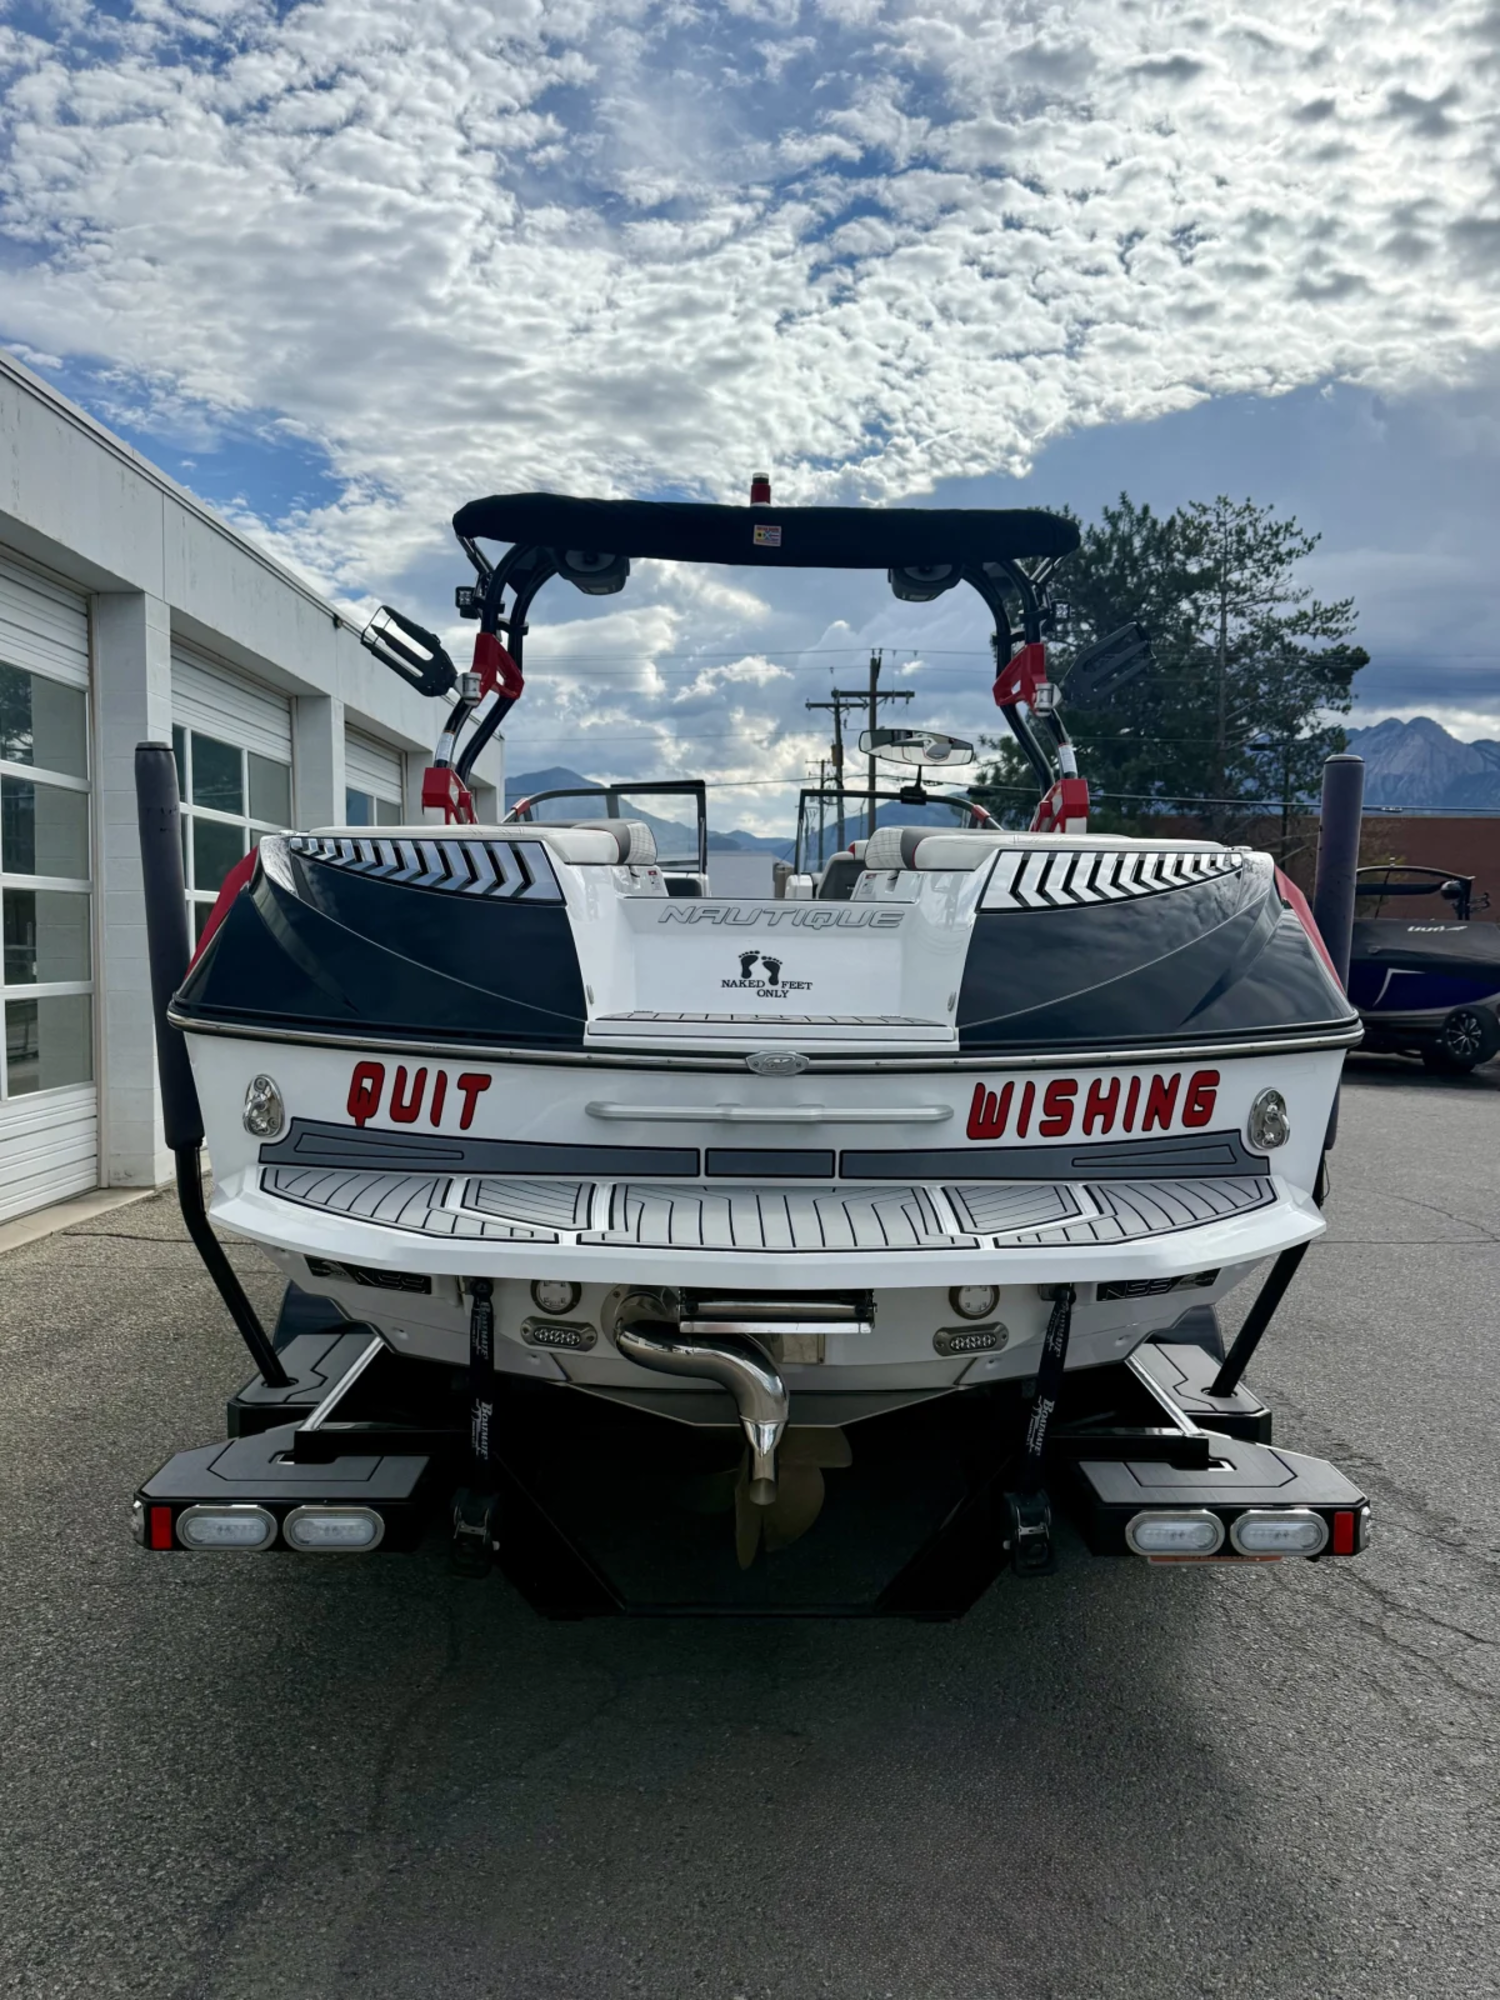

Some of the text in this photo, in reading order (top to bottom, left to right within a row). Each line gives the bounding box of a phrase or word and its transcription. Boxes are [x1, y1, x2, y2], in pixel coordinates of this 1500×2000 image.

[658, 904, 905, 929] NAUTIQUE
[721, 979, 813, 990] NAKED FEET
[757, 988, 789, 998] ONLY
[346, 1060, 492, 1131] QUIT
[966, 1069, 1221, 1141] WISHING
